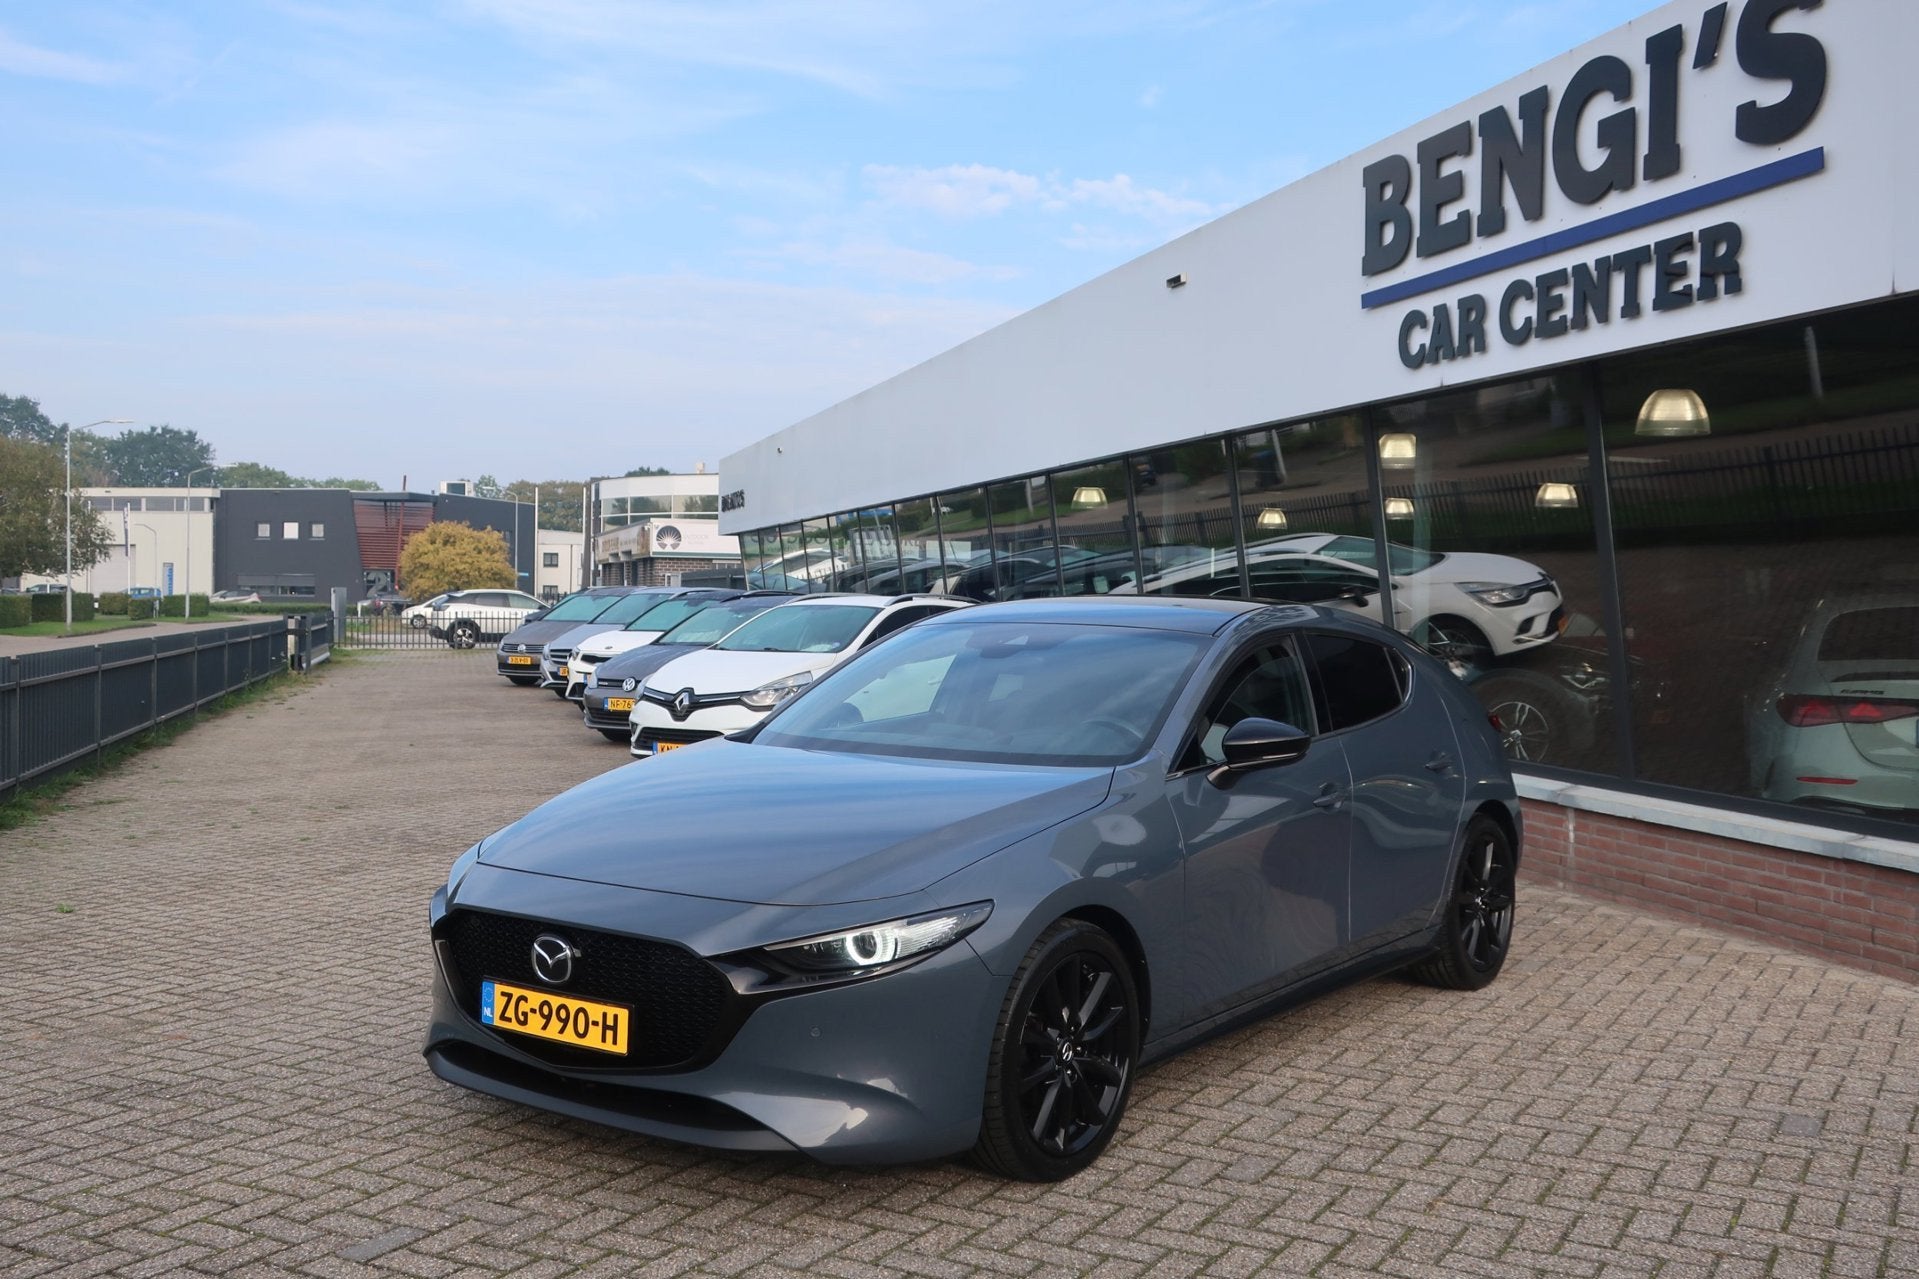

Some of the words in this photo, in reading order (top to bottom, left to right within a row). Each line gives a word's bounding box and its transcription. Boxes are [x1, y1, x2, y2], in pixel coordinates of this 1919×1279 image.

[1361, 0, 1827, 276] BENGI'S
[1399, 293, 1486, 369] CAR
[1499, 221, 1743, 346] CENTER
[498, 990, 620, 1046] ZG-990-H
